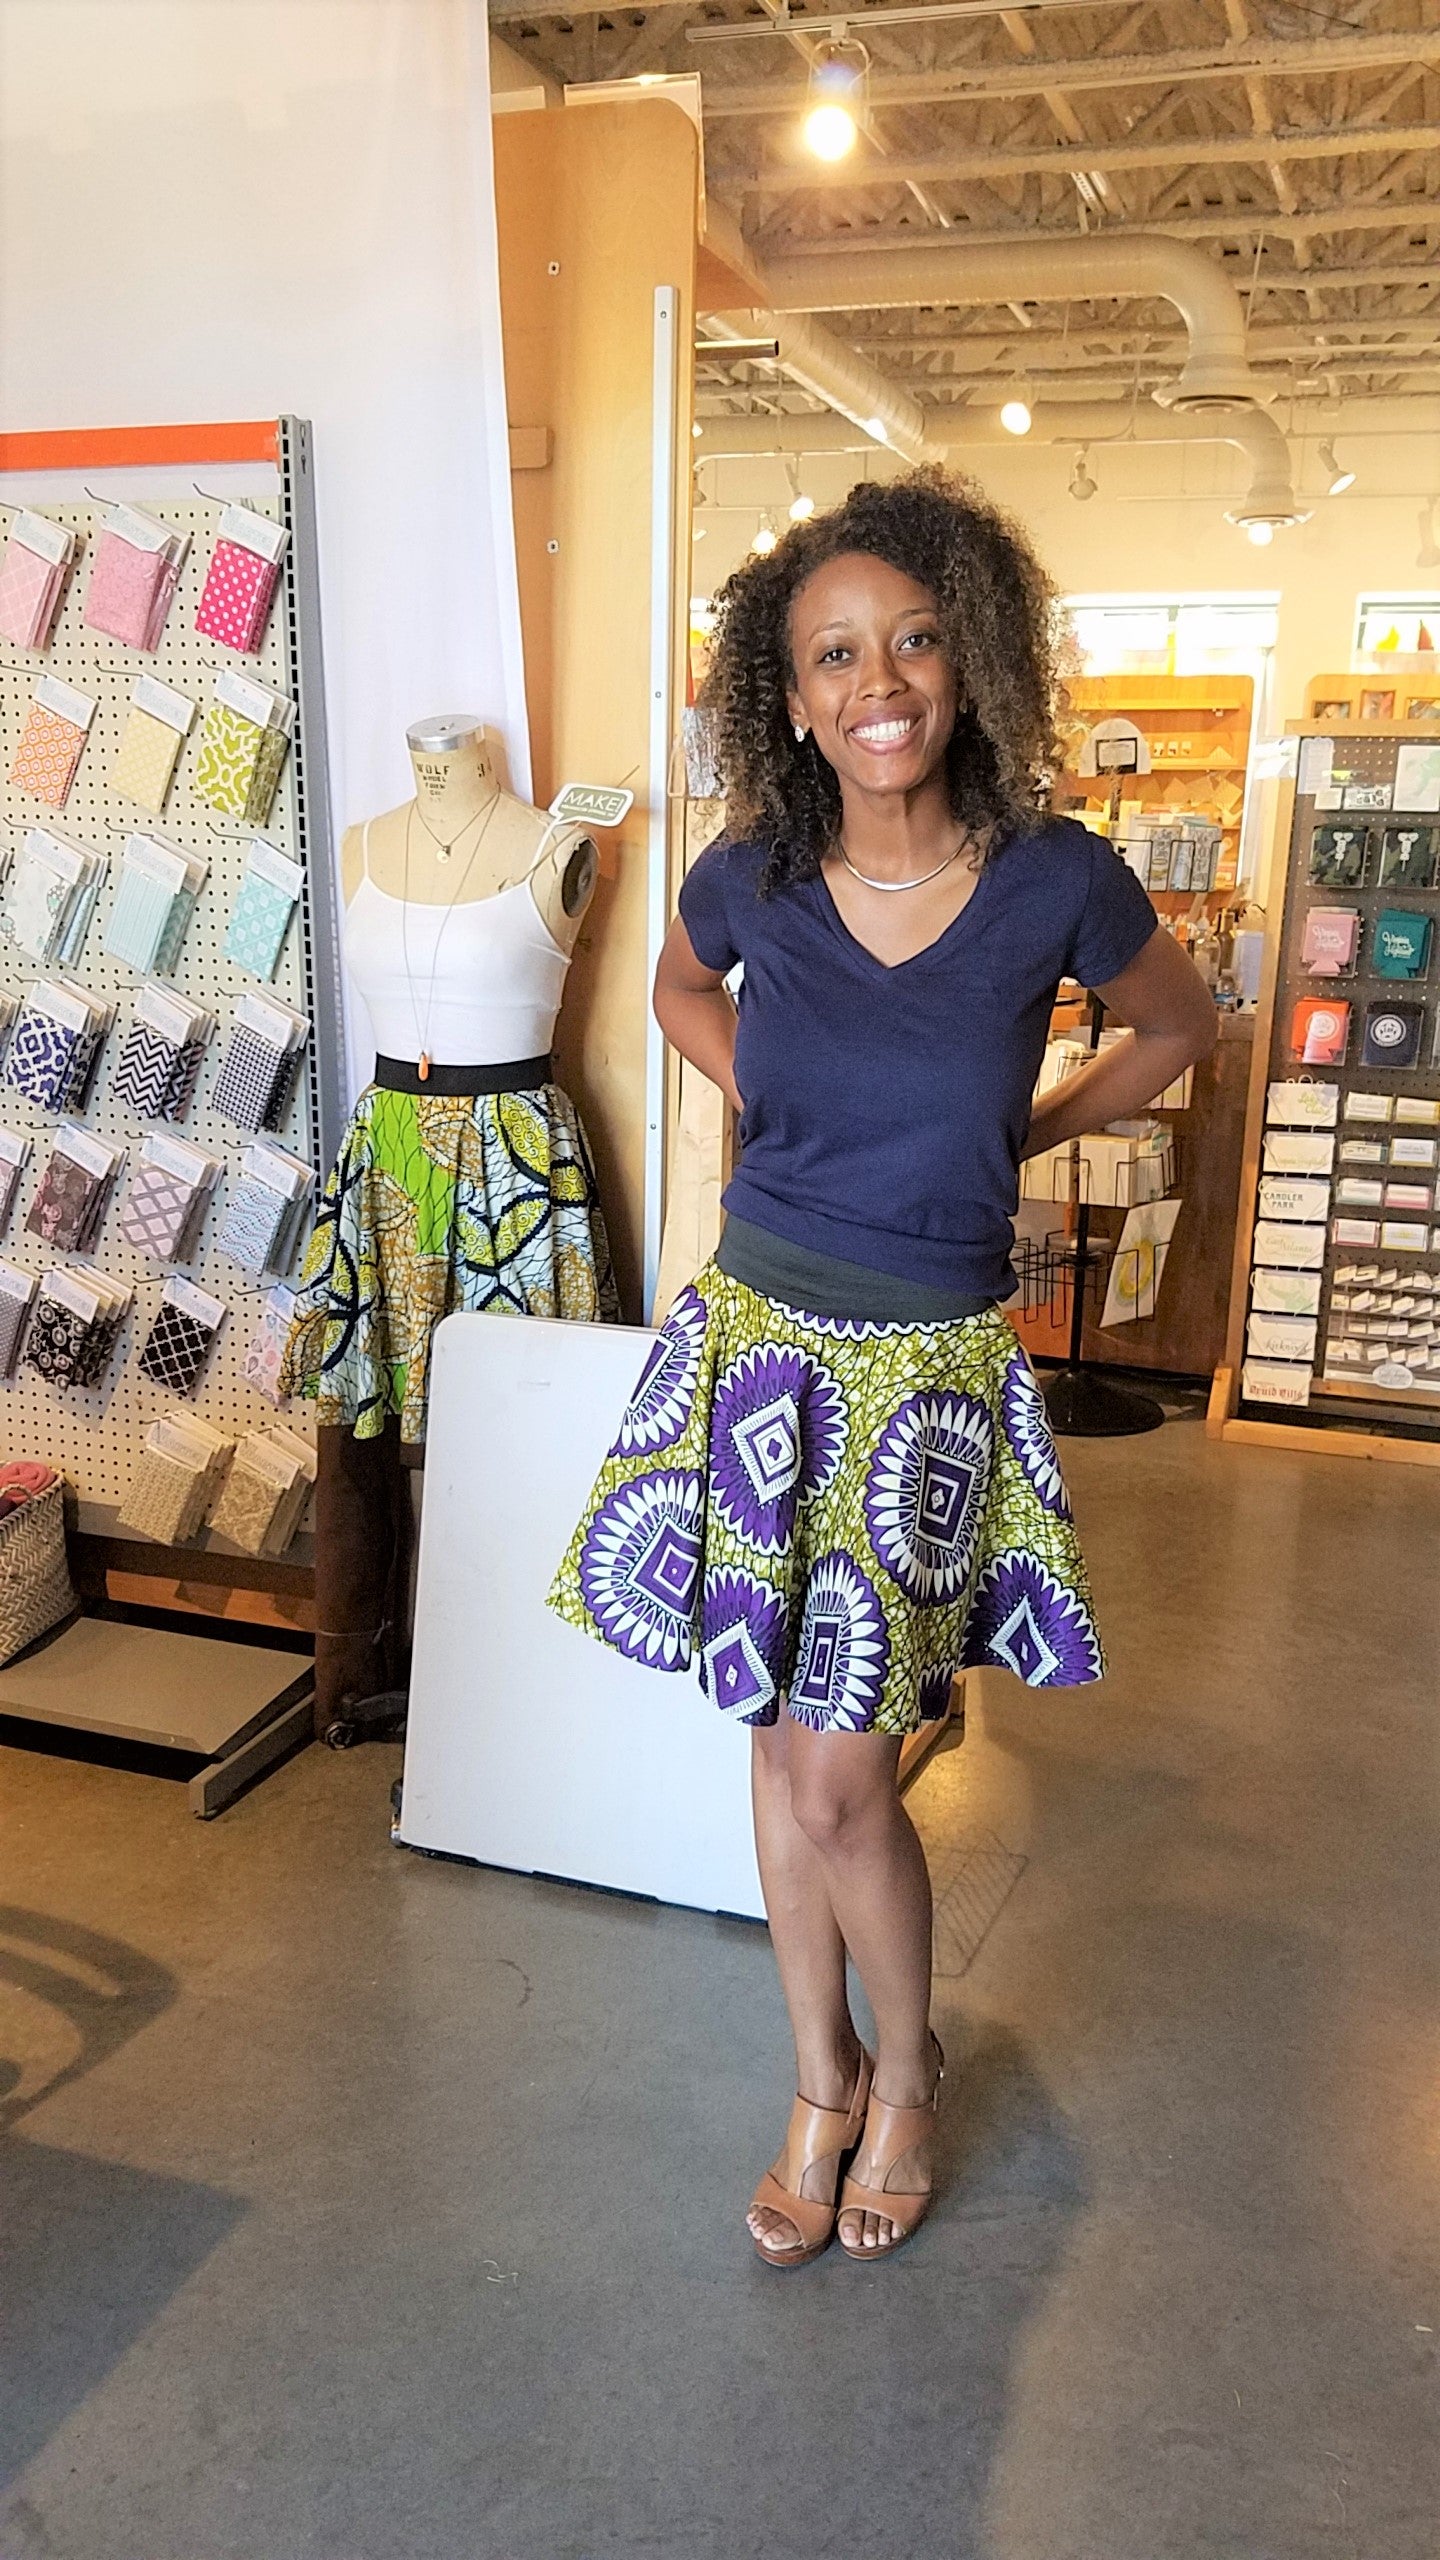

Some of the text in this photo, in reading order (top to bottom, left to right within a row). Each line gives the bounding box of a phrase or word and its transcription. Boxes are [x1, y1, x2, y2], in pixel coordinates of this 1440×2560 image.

[416, 763, 450, 775] WOLF
[564, 790, 625, 814] MAKE!
[1263, 1191, 1304, 1203] CANDLER
[1272, 1200, 1295, 1210] PARK
